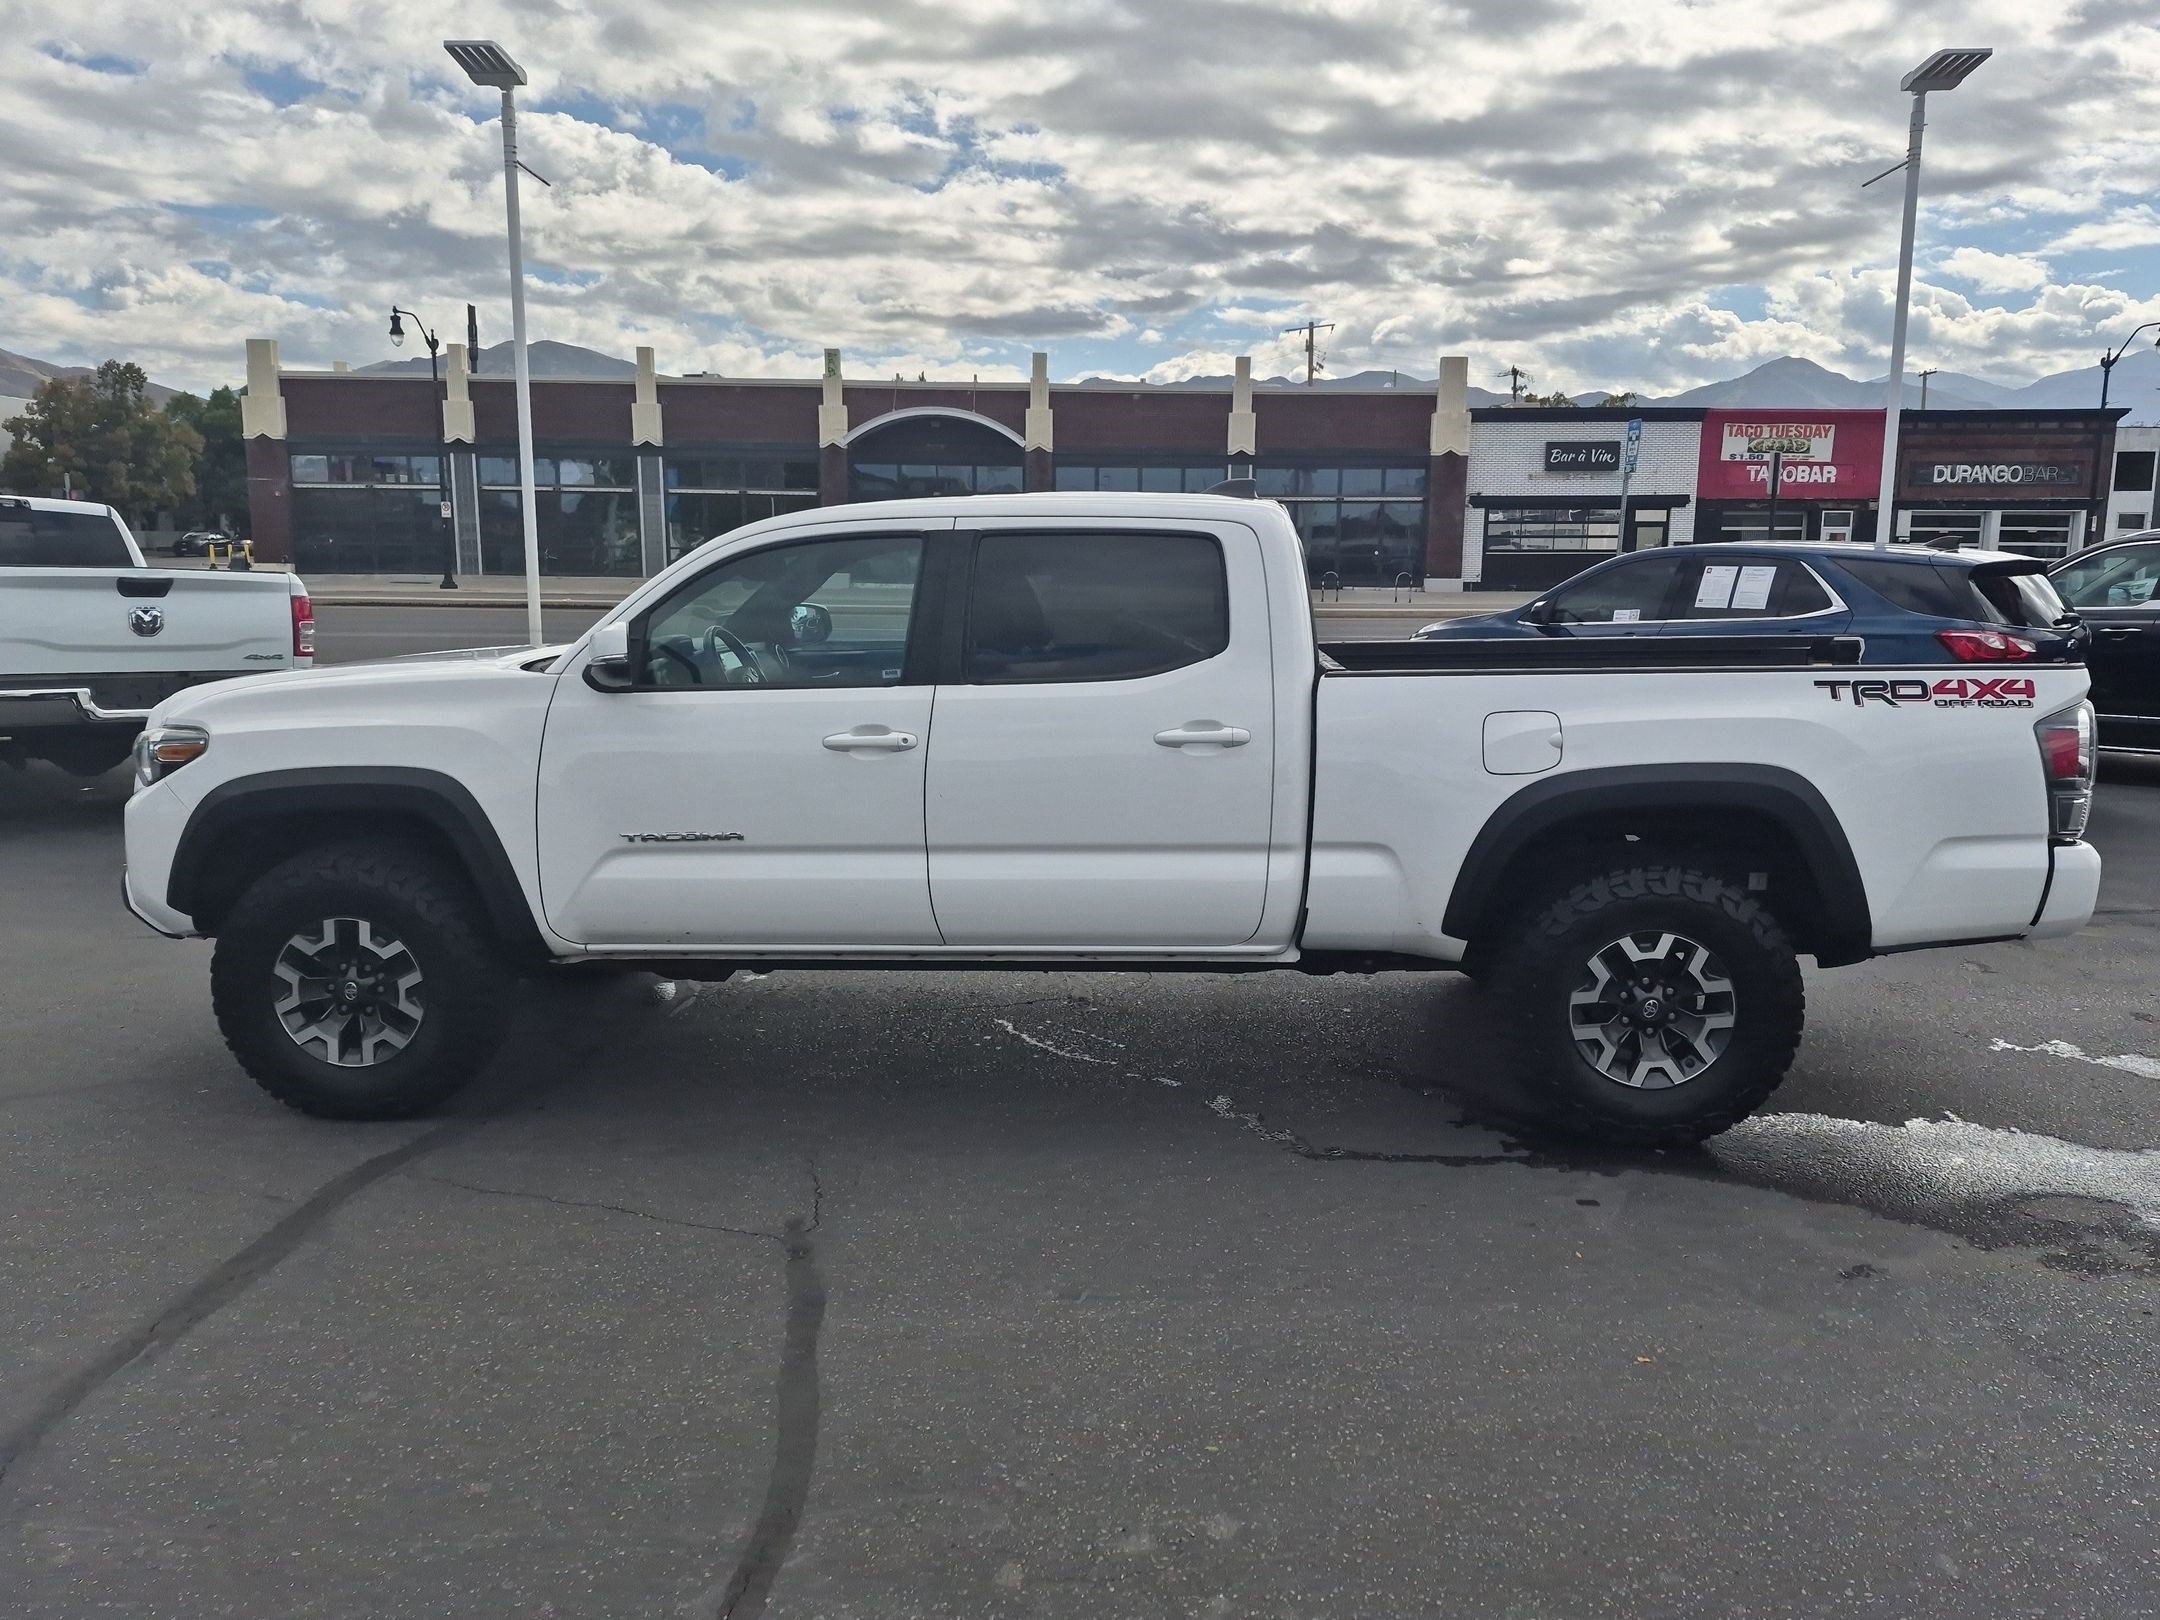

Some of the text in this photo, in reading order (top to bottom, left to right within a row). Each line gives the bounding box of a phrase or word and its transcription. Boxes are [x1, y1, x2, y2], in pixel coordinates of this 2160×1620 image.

[1727, 424, 1833, 439] TACO TUESDAY
[1550, 448, 1616, 463] Bar à Vin
[1728, 453, 1765, 461] $1.50
[1746, 465, 1838, 483] TAOBAR
[1934, 699, 2034, 709] OFF ROAD
[619, 831, 745, 842] TACOMA
